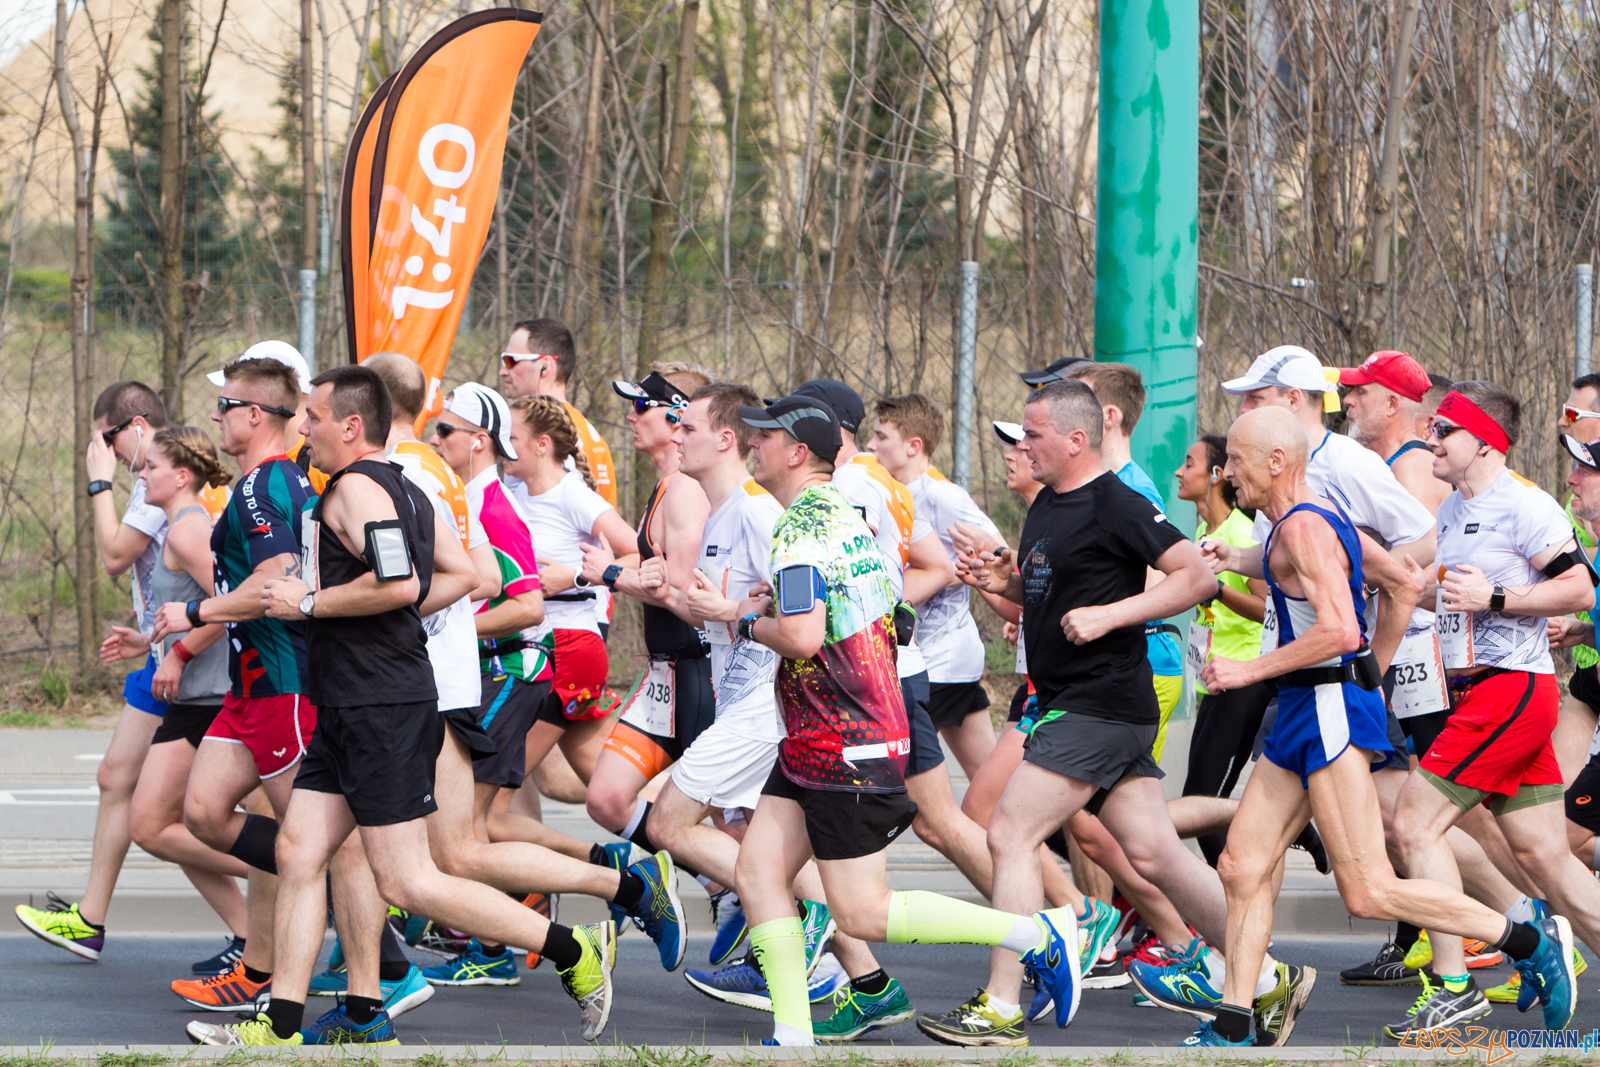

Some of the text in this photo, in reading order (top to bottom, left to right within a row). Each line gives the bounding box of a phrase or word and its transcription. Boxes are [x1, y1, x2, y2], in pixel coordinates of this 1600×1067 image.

[391, 123, 476, 319] 1:40
[245, 497, 258, 510] TO
[1264, 608, 1276, 631] 28
[1438, 613, 1460, 635] 3673
[1394, 662, 1428, 687] 323
[855, 972, 881, 984] HEAD
